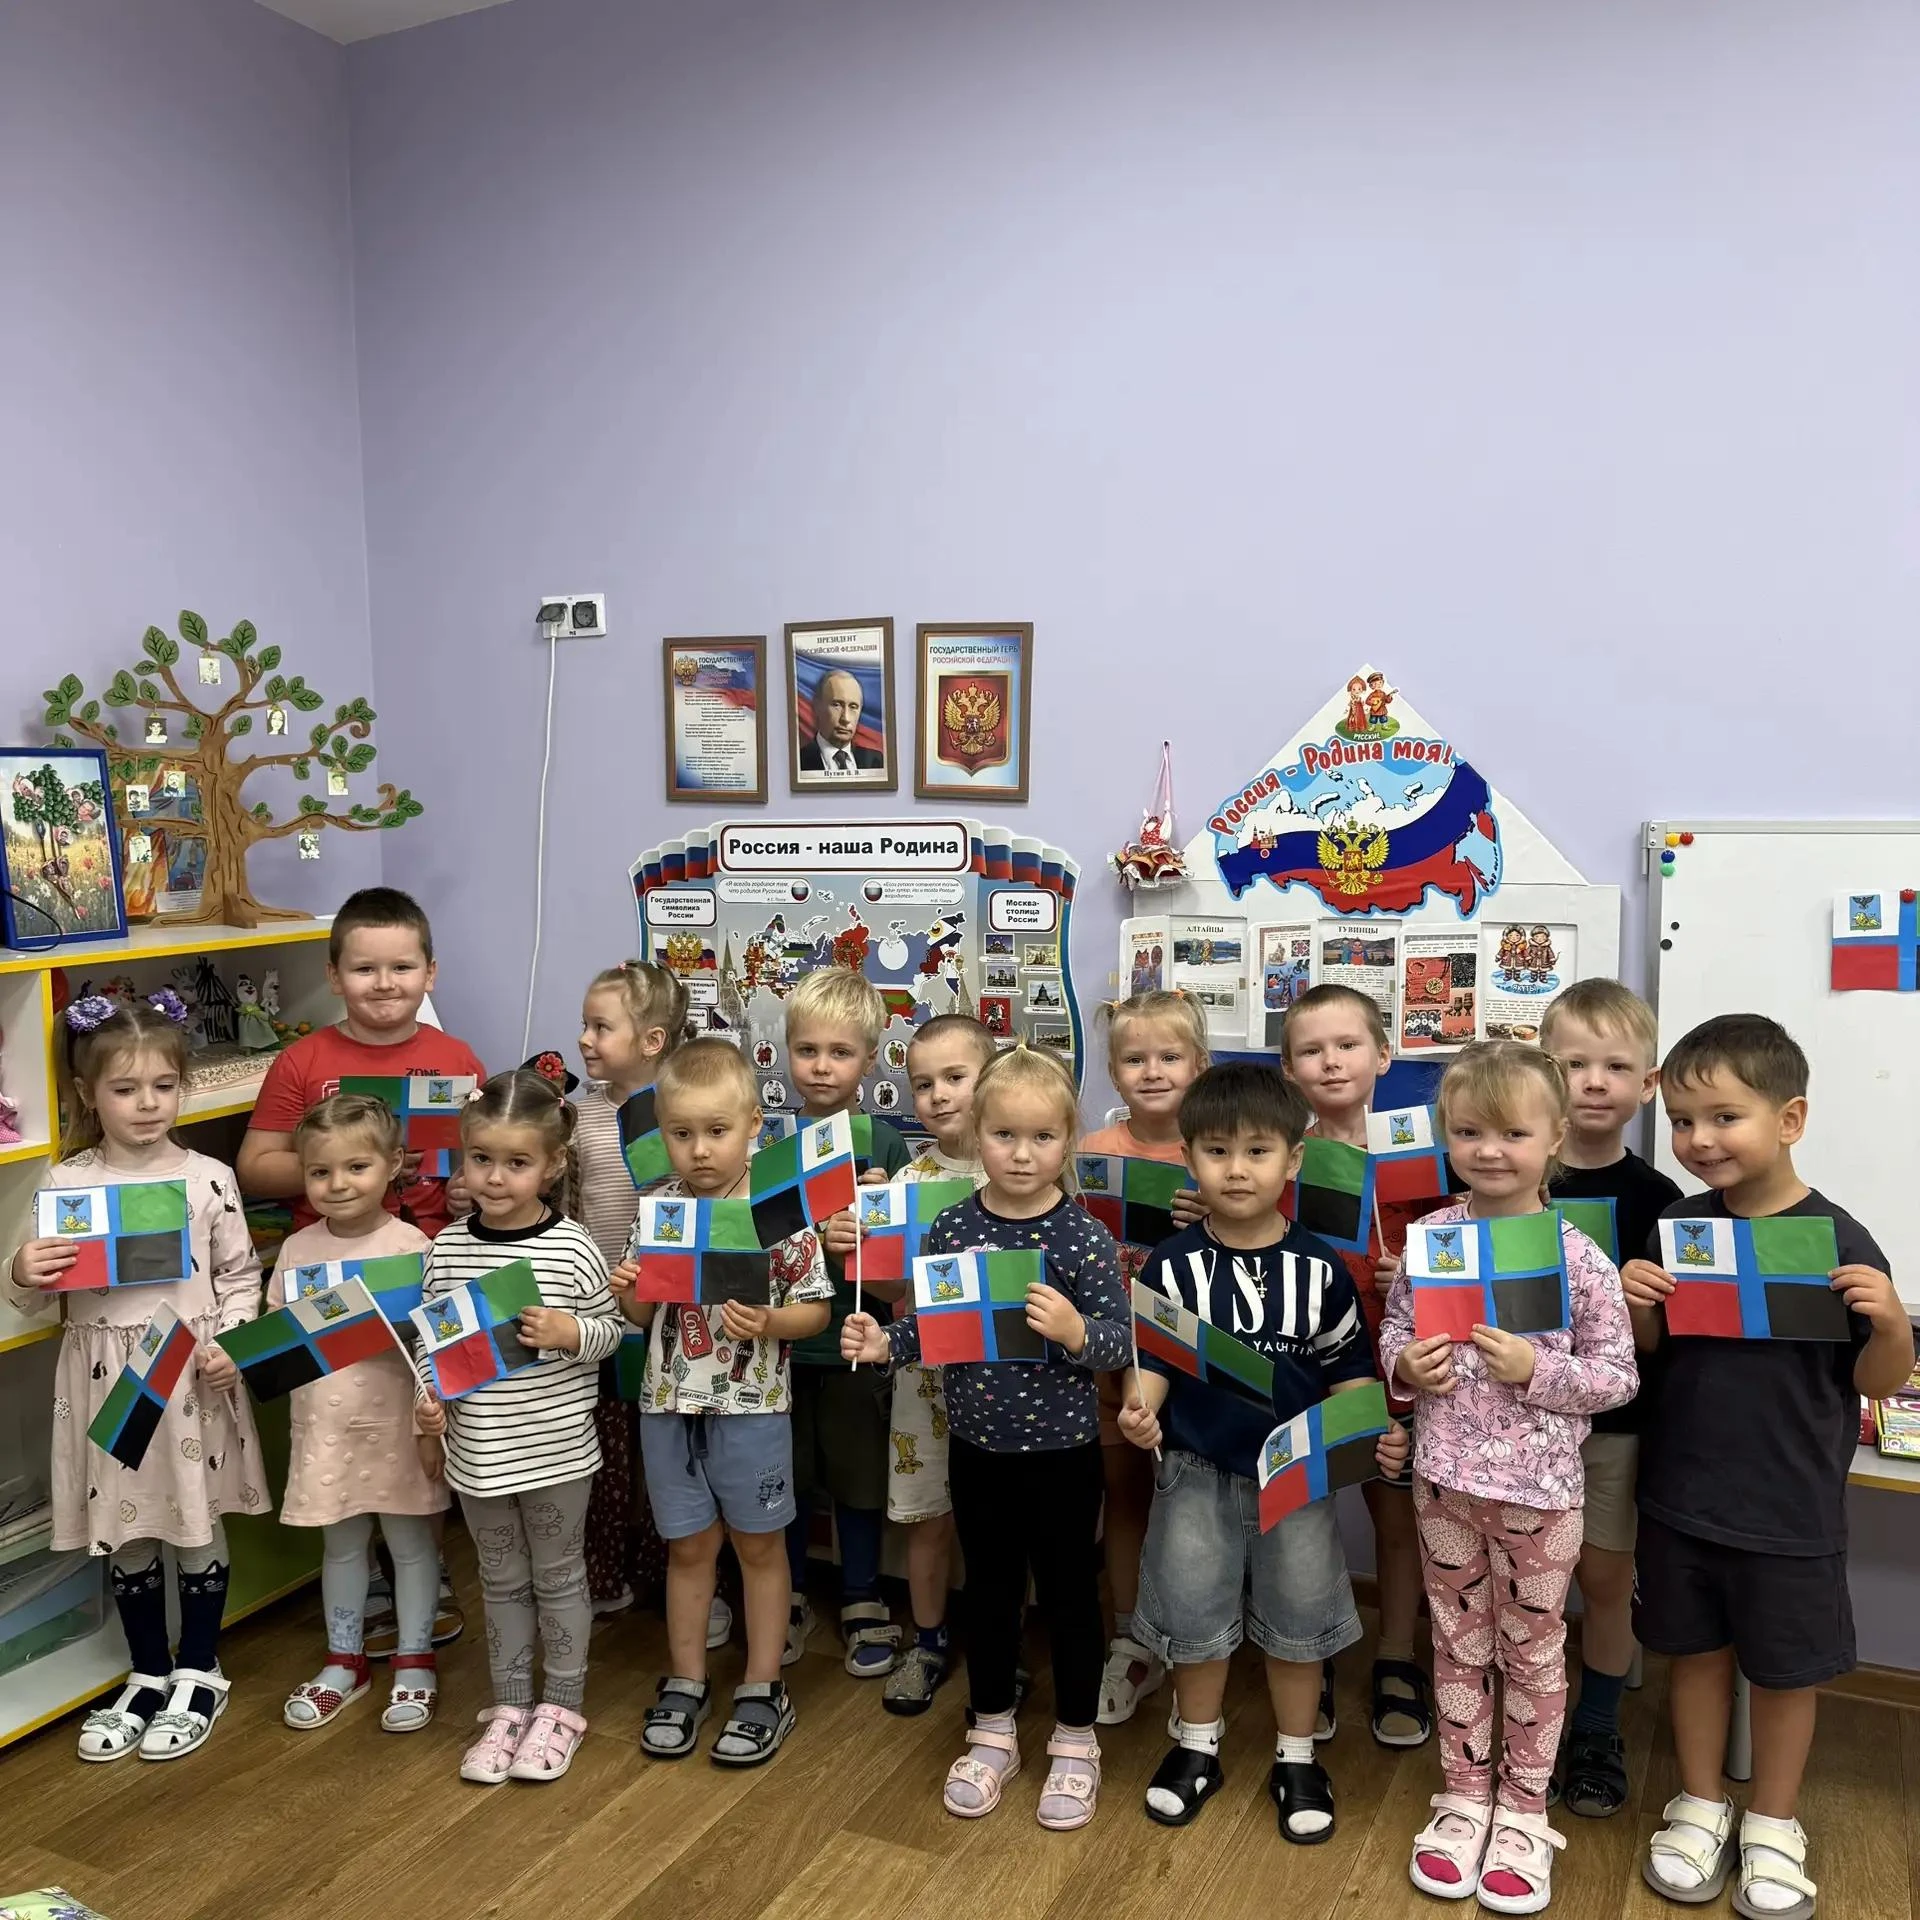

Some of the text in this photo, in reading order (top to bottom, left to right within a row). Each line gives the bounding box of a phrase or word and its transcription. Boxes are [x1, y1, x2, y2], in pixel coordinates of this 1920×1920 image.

[929, 644, 1019, 654] ГОСУДАРСТВЕННЫЙ ГЕРБ
[1210, 770, 1282, 836] Россия
[1302, 739, 1384, 774] Родина
[1393, 742, 1453, 766] моя!
[729, 839, 800, 855] Россия
[818, 840, 873, 854] наша
[880, 838, 959, 857] Родина
[650, 896, 711, 905] Государственная
[1006, 899, 1039, 907] Москва-
[1338, 926, 1379, 934] ТУВИНЦЫ
